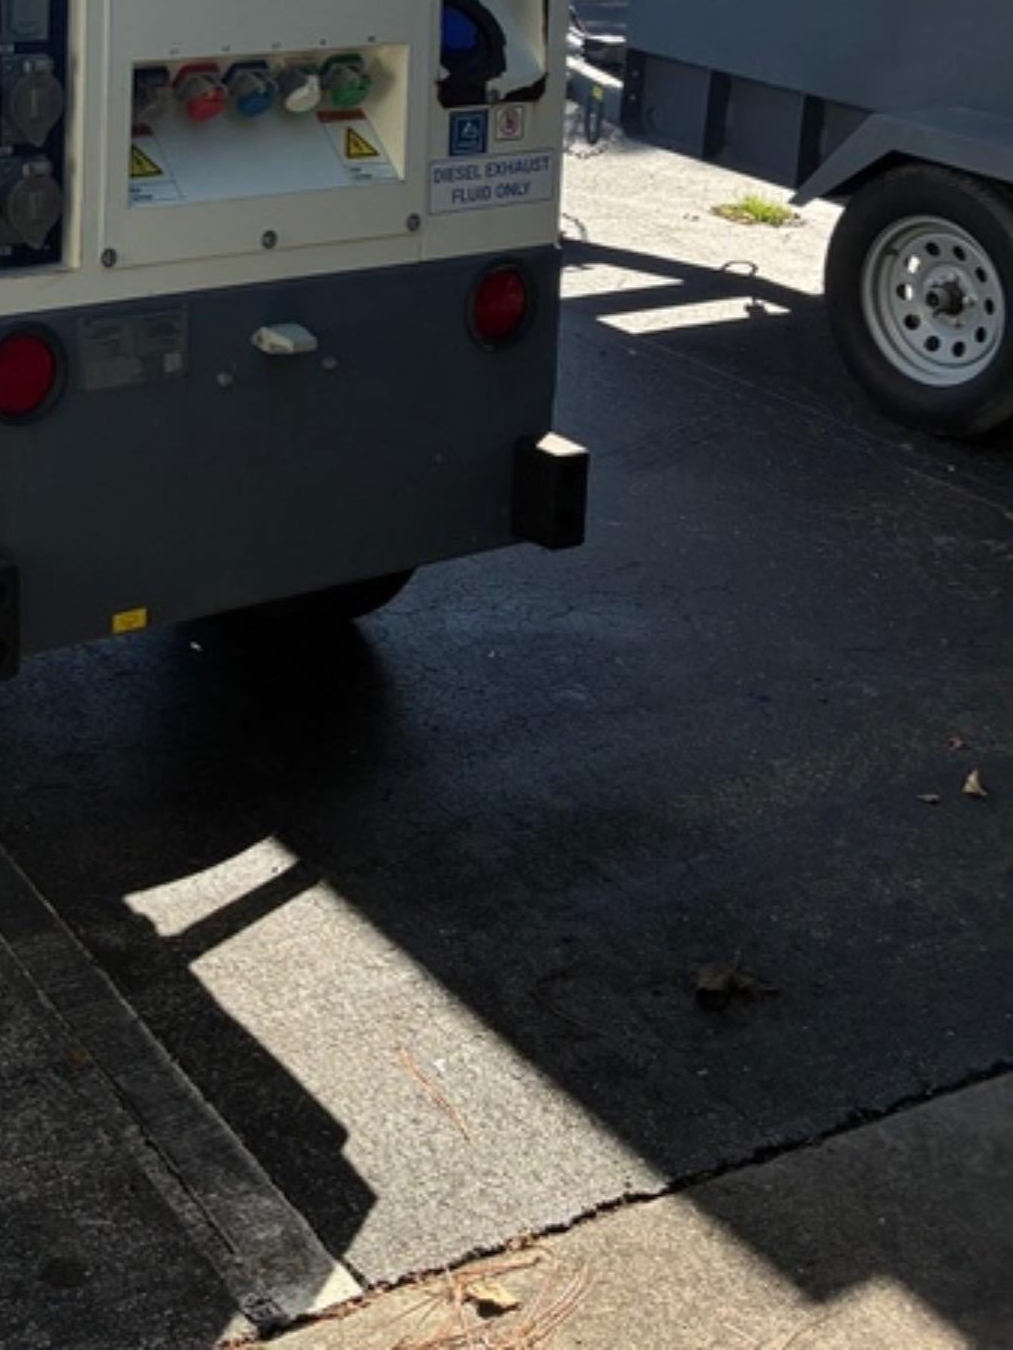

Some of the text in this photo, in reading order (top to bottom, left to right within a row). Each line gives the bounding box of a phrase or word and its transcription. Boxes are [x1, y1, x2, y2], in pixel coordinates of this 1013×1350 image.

[433, 155, 551, 184] DIESEL EXHAUST
[451, 181, 532, 205] FLUID ONLY
